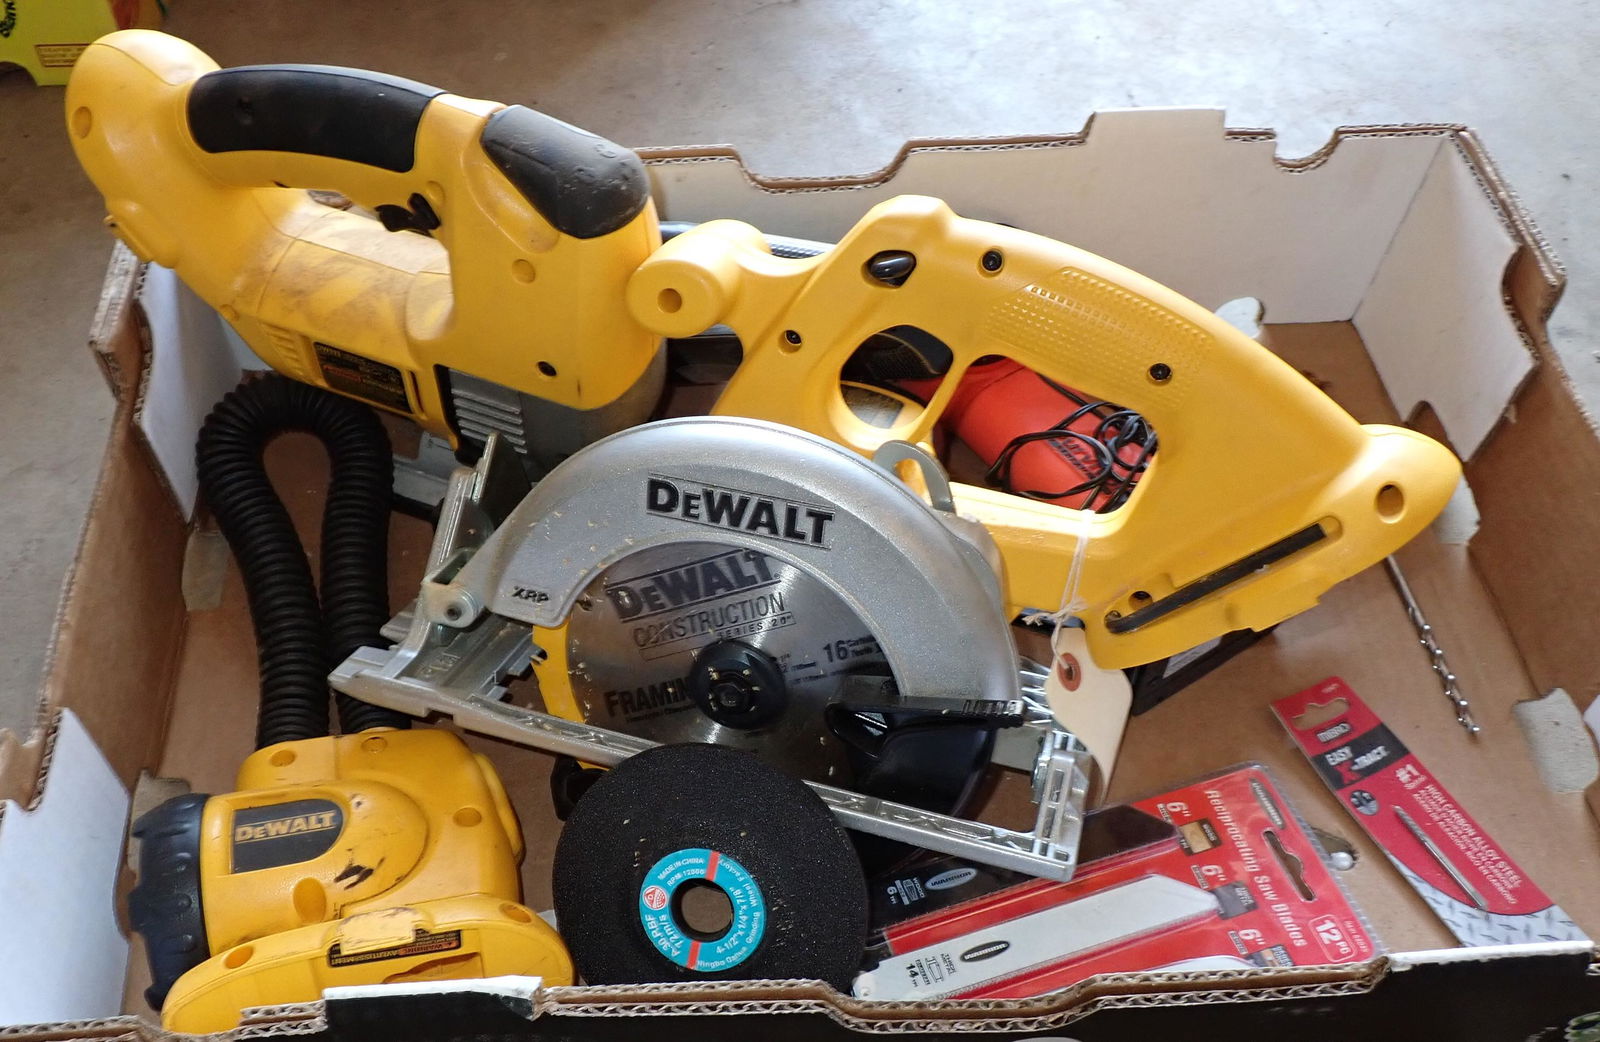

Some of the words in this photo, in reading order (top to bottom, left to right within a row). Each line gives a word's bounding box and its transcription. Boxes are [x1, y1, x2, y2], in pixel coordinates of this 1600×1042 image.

[647, 478, 834, 544] DEWALT
[633, 591, 786, 649] CONSTRUCTION
[822, 639, 848, 663] 16
[604, 675, 697, 718] FRAMIN
[234, 812, 336, 842] DEWALT
[718, 858, 746, 882] Factory
[1203, 790, 1262, 872] Reciprocating
[1254, 875, 1282, 901] Saw
[1271, 903, 1308, 946] Blades
[887, 886, 898, 895] 6
[1316, 919, 1342, 945] 12
[906, 963, 920, 979] 14
